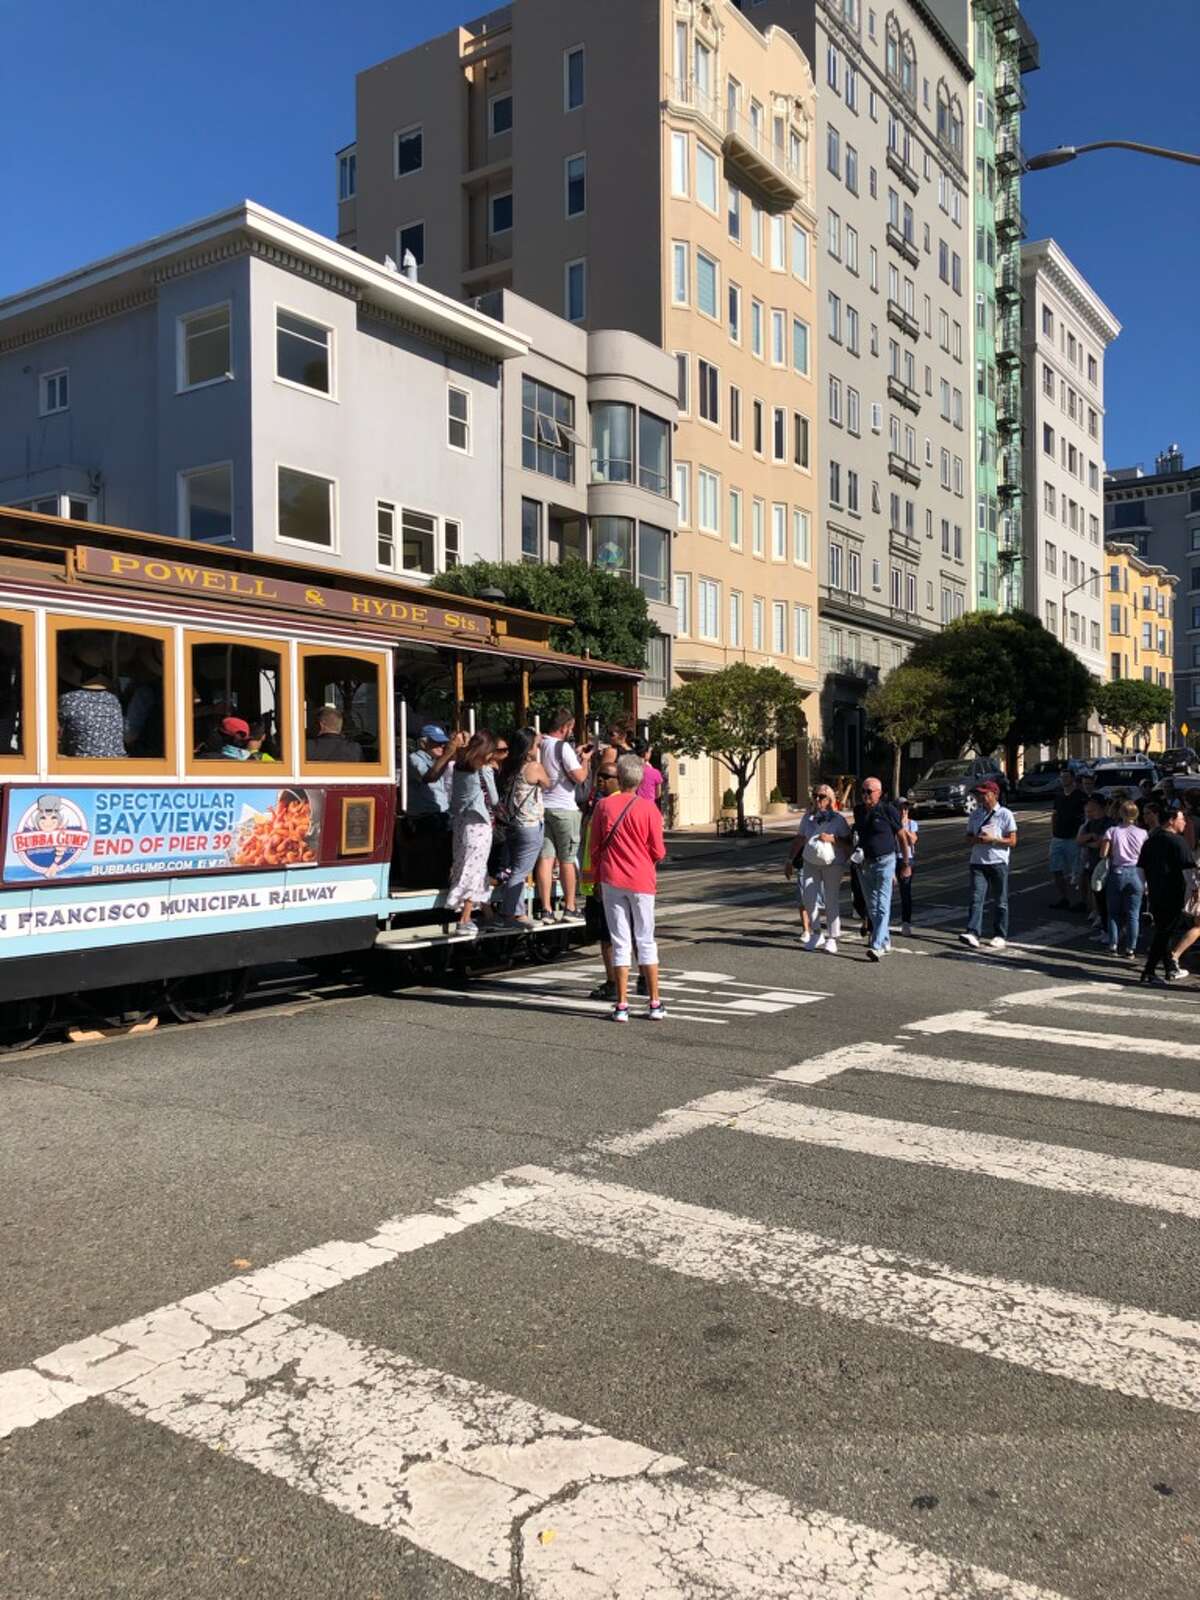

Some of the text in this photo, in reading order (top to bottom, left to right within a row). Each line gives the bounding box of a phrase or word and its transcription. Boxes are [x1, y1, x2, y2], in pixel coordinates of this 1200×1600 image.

[110, 555, 277, 598] POWELL
[305, 588, 325, 608] &
[351, 597, 429, 623] HYDE
[96, 793, 235, 810] SPECTACULAR
[95, 811, 234, 835] BAY VIEWS!
[15, 834, 54, 850] BUBBA
[93, 834, 232, 856] END OF PIER 39
[91, 861, 192, 875] BUBBAGUMP.COM
[18, 902, 150, 929] FRANCISCO
[160, 893, 261, 916] MUNICIPAL
[269, 886, 337, 905] RAILWAY
